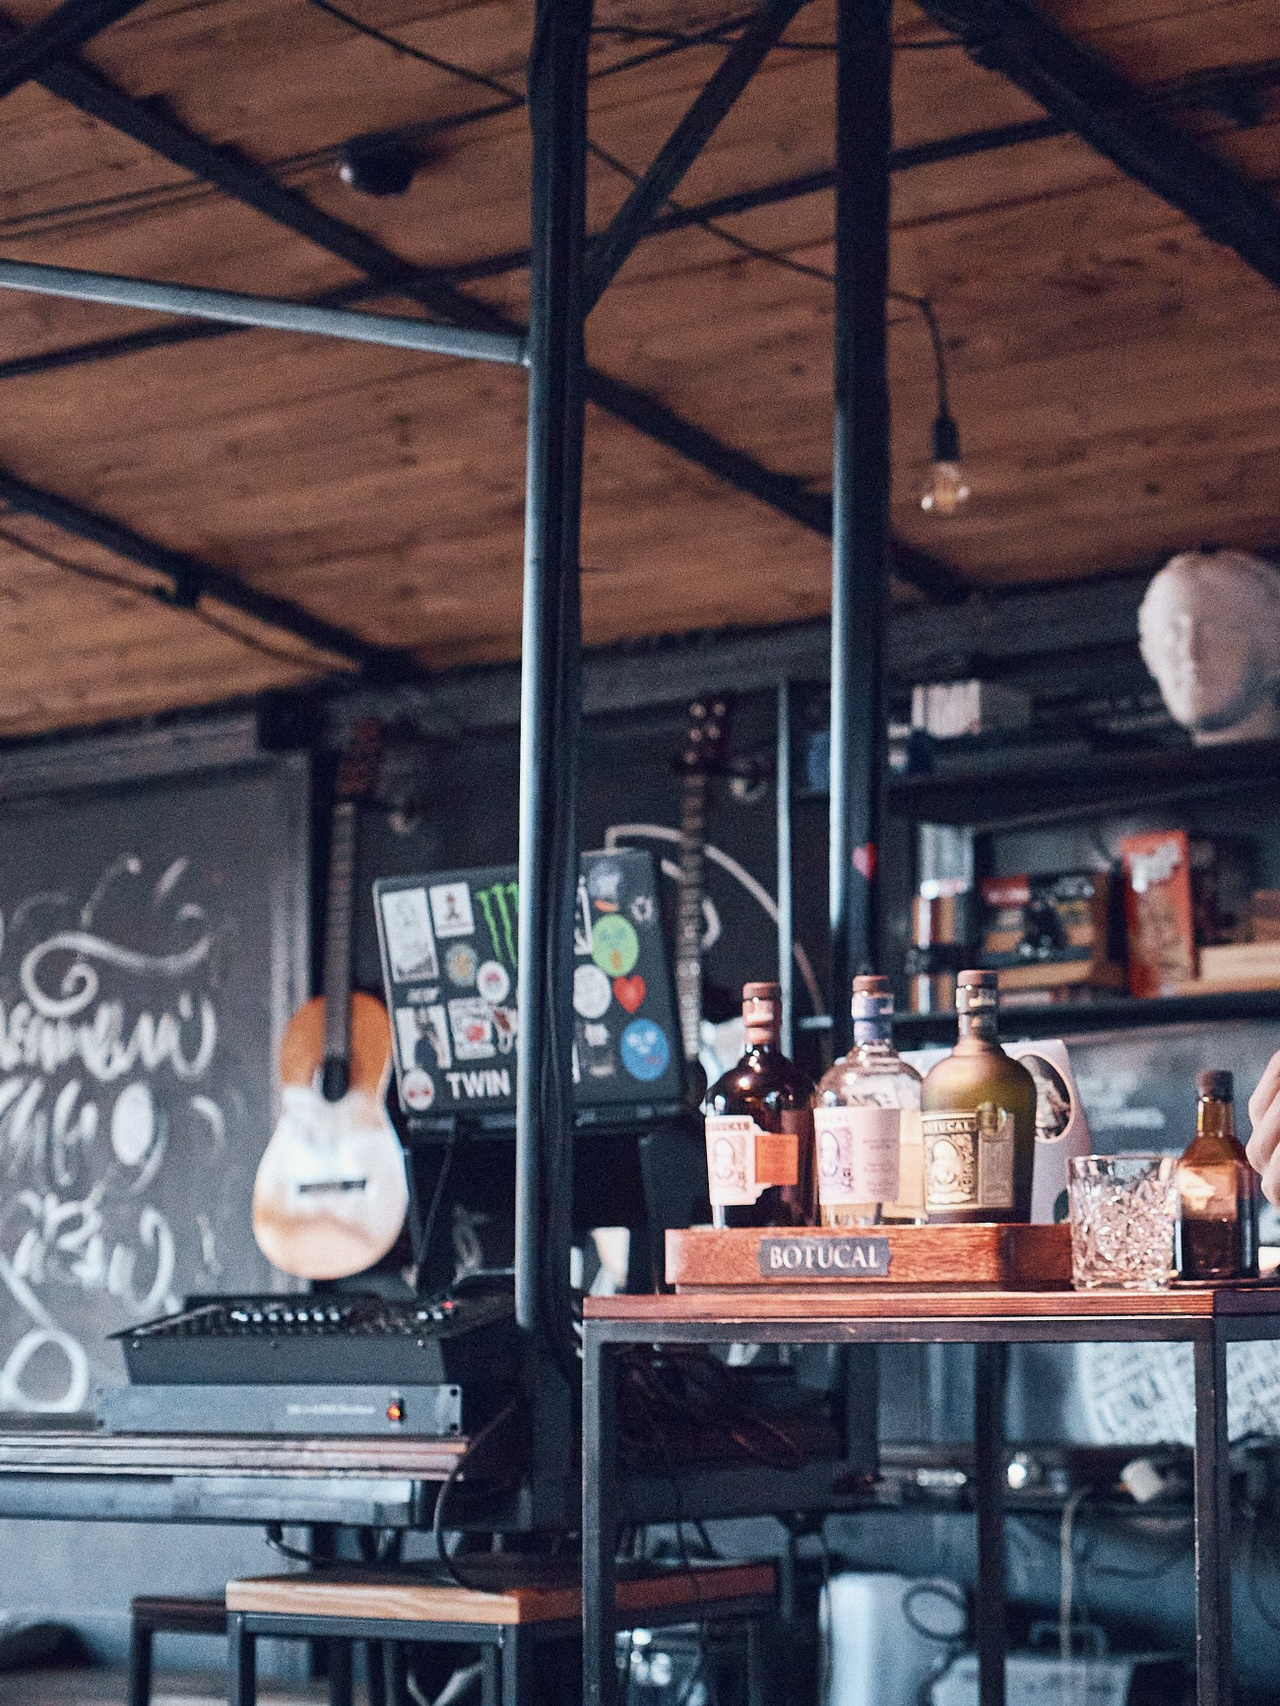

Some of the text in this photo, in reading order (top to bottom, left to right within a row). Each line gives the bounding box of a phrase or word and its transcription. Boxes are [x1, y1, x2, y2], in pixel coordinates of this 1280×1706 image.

[446, 1068, 511, 1100] TWIN
[924, 1120, 971, 1133] TUCAL
[769, 1243, 881, 1269] BOTUCAL
